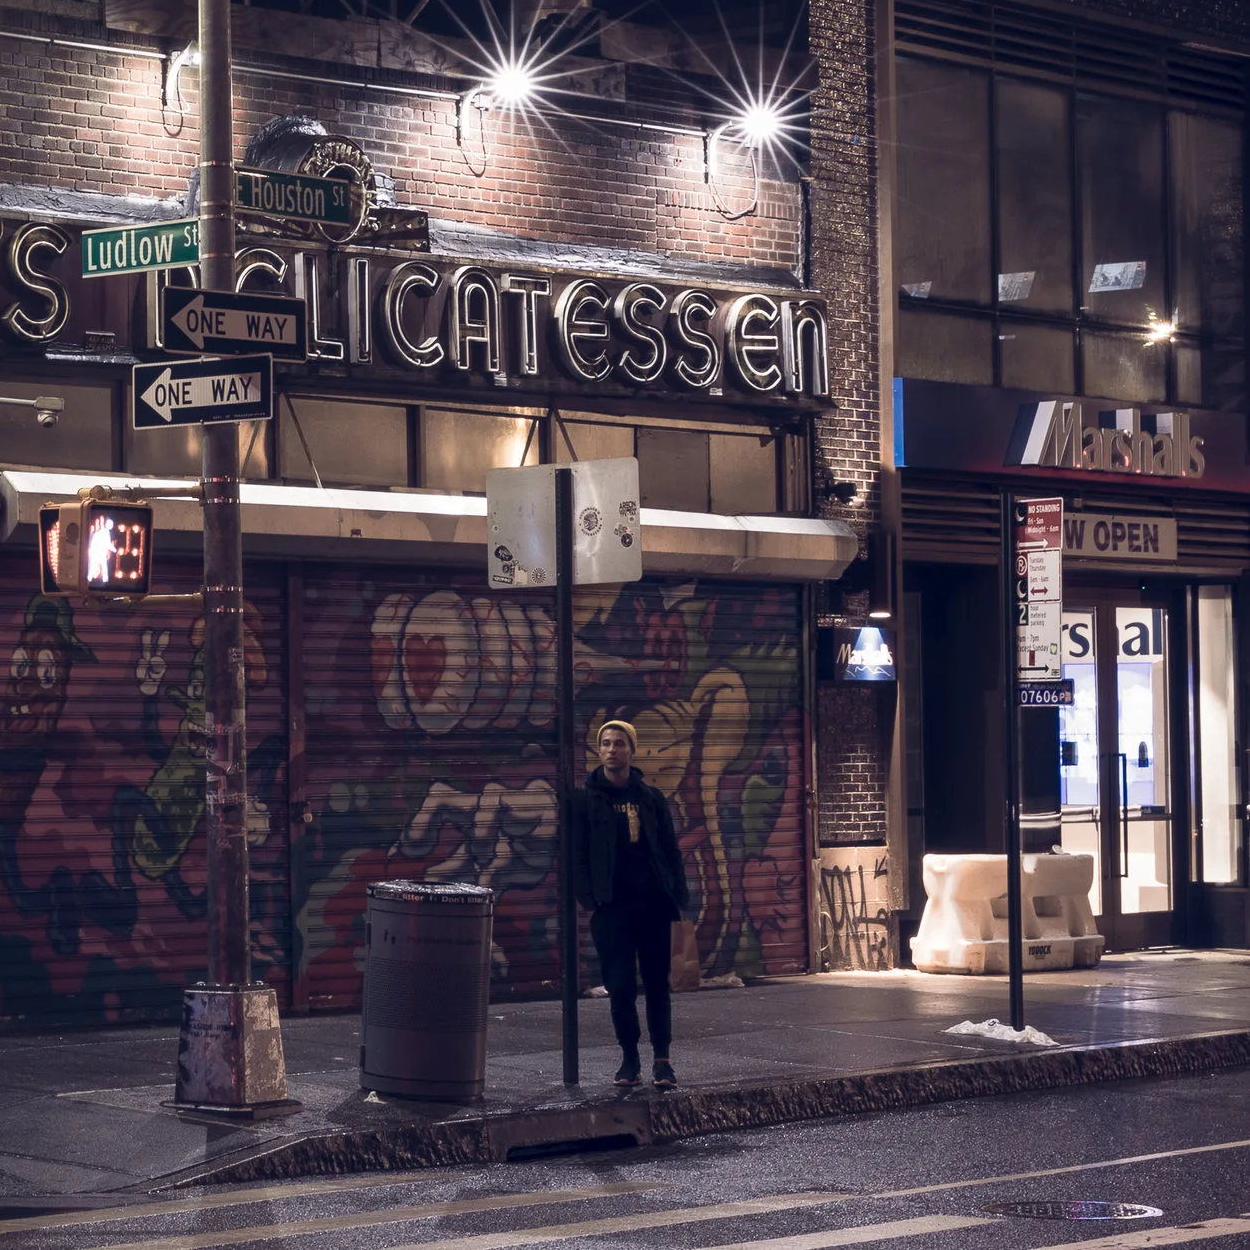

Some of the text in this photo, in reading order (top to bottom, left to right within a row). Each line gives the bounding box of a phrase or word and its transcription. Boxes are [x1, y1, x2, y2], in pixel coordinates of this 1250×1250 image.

[251, 177, 326, 217] Houston
[332, 185, 345, 207] St
[87, 223, 199, 271] Ludlow St
[186, 309, 288, 341] ONE WAY
[155, 376, 253, 407] ONE WAY
[1032, 400, 1206, 479] Marshalls
[1028, 503, 1060, 514] NO STANDING
[1093, 520, 1160, 554] OPEN
[1019, 605, 1026, 624] 2
[835, 643, 894, 666] Marlls
